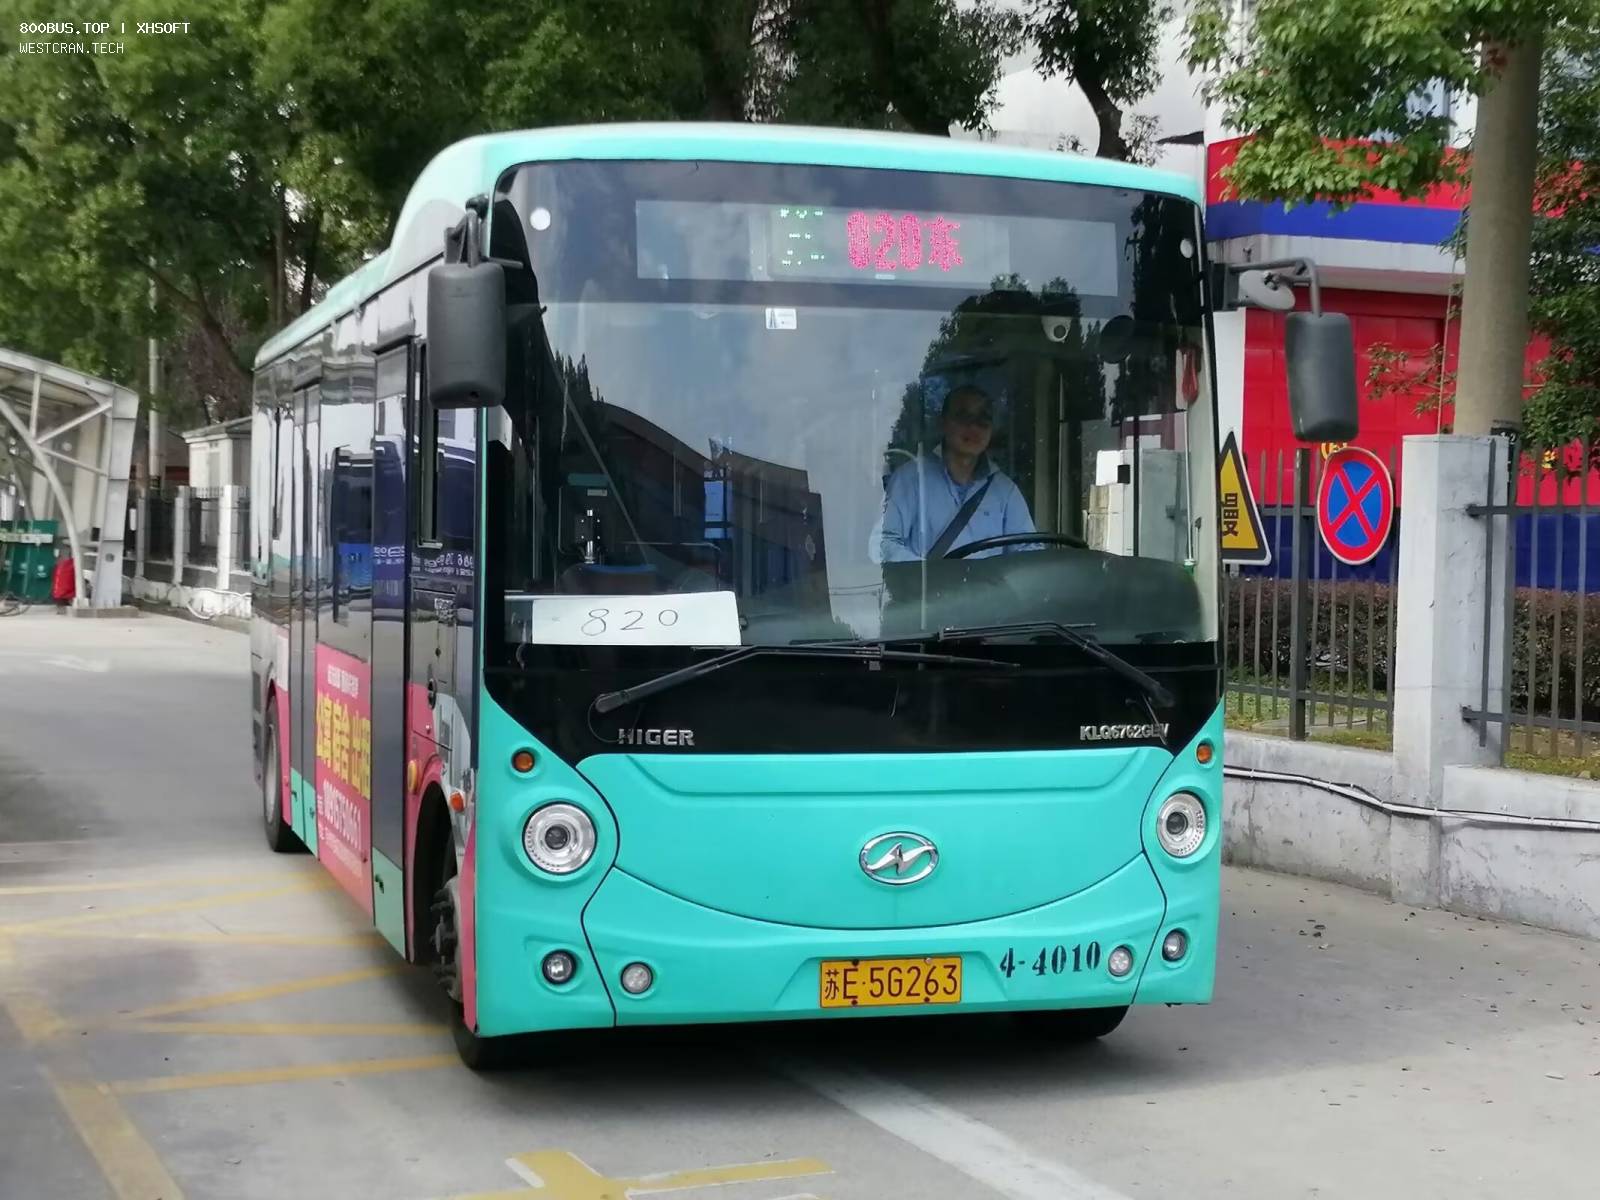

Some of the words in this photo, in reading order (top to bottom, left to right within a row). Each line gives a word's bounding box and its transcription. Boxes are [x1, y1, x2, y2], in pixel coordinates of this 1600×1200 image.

[580, 608, 679, 637] 820
[617, 728, 695, 747] HIGER
[999, 940, 1101, 979] 4-4010
